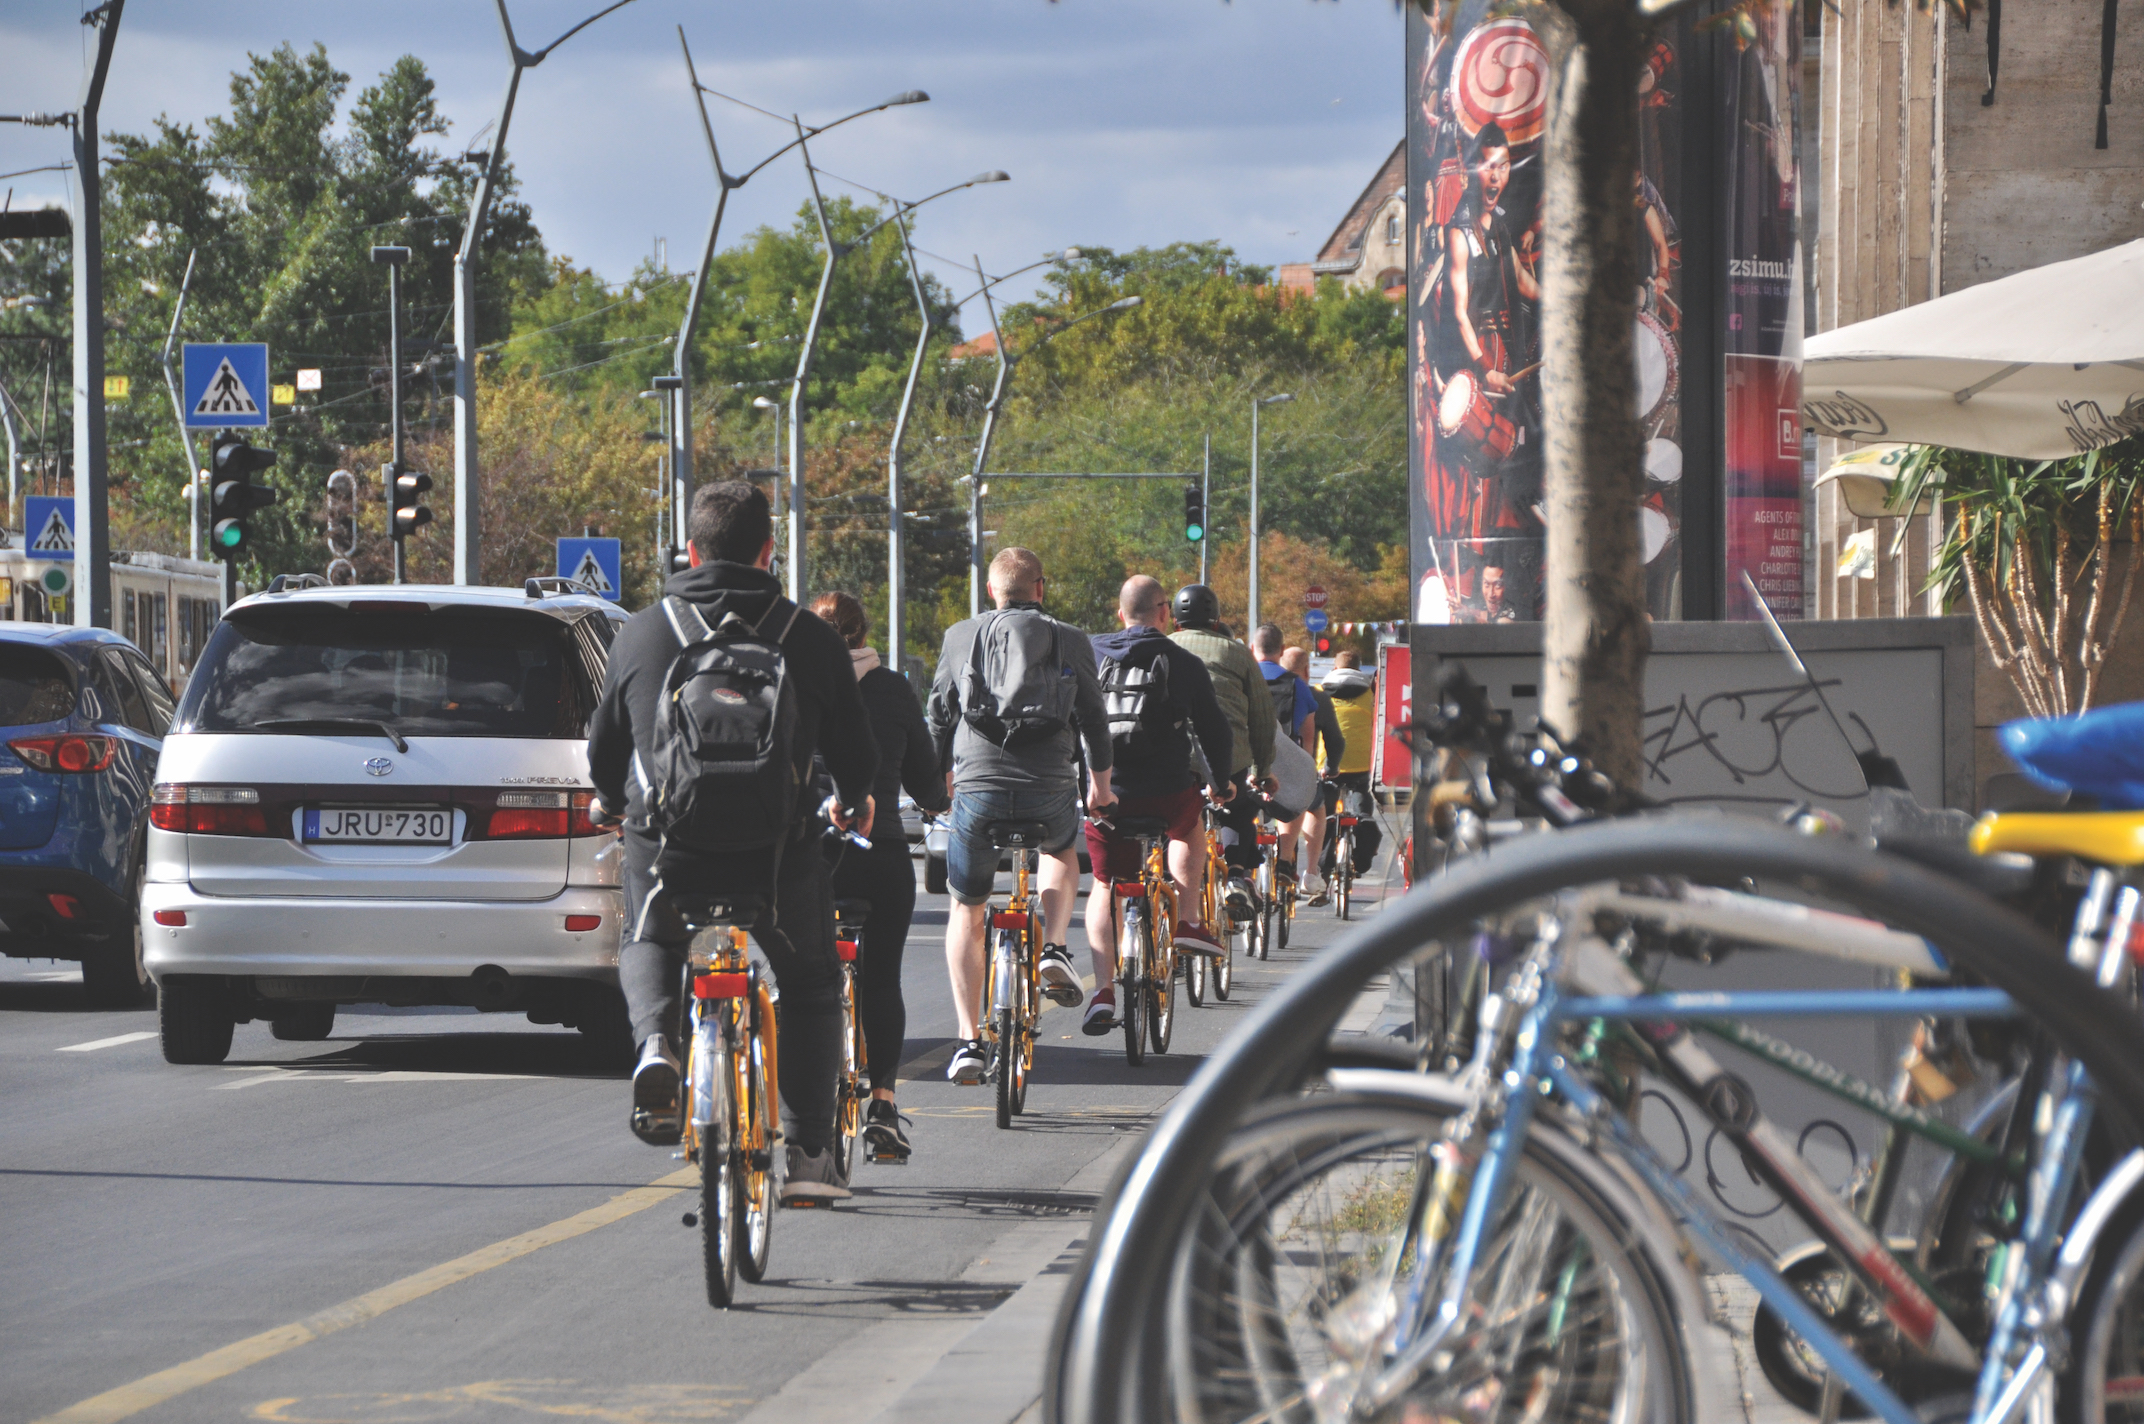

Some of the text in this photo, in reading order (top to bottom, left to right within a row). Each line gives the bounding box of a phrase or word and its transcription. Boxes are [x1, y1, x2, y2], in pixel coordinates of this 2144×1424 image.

[1729, 254, 1797, 280] zsimu.h
[1755, 511, 1784, 524] AGENTS
[1760, 579, 1781, 592] CHRIS
[1306, 592, 1327, 602] STOP
[527, 777, 581, 785] PREVIA
[309, 826, 316, 835] H
